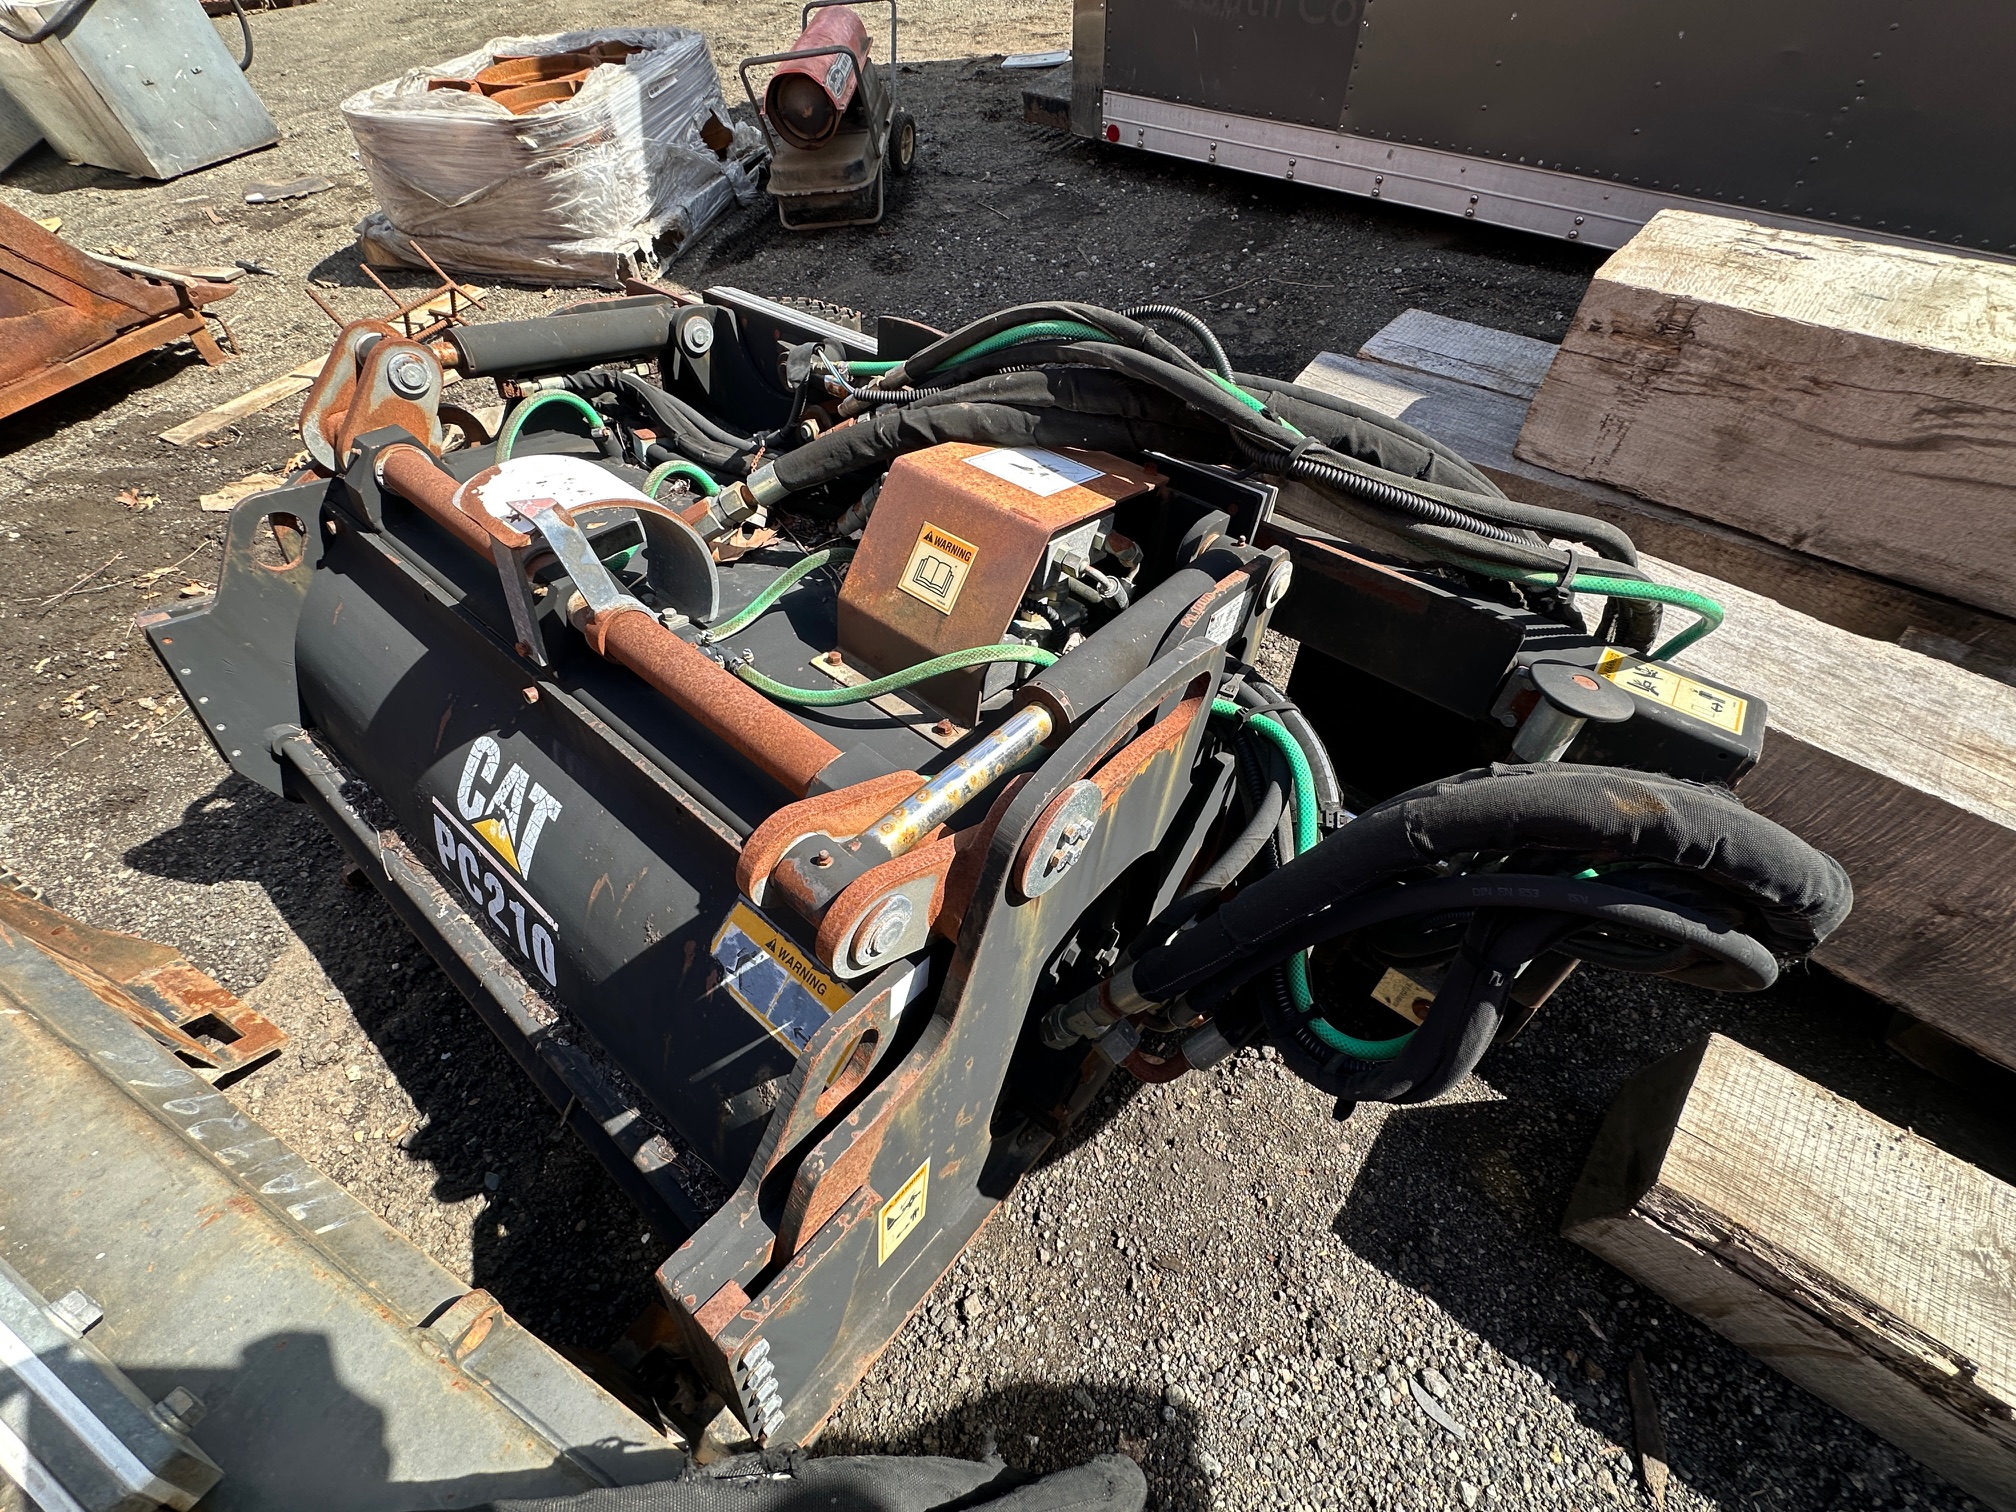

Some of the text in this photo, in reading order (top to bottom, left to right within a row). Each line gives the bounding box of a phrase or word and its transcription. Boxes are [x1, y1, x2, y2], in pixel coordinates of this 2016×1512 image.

[933, 535, 972, 562] WARNING
[457, 736, 563, 882] CAT
[433, 813, 557, 987] PC210
[1472, 886, 1492, 897] DIN
[778, 946, 827, 996] WARNING
